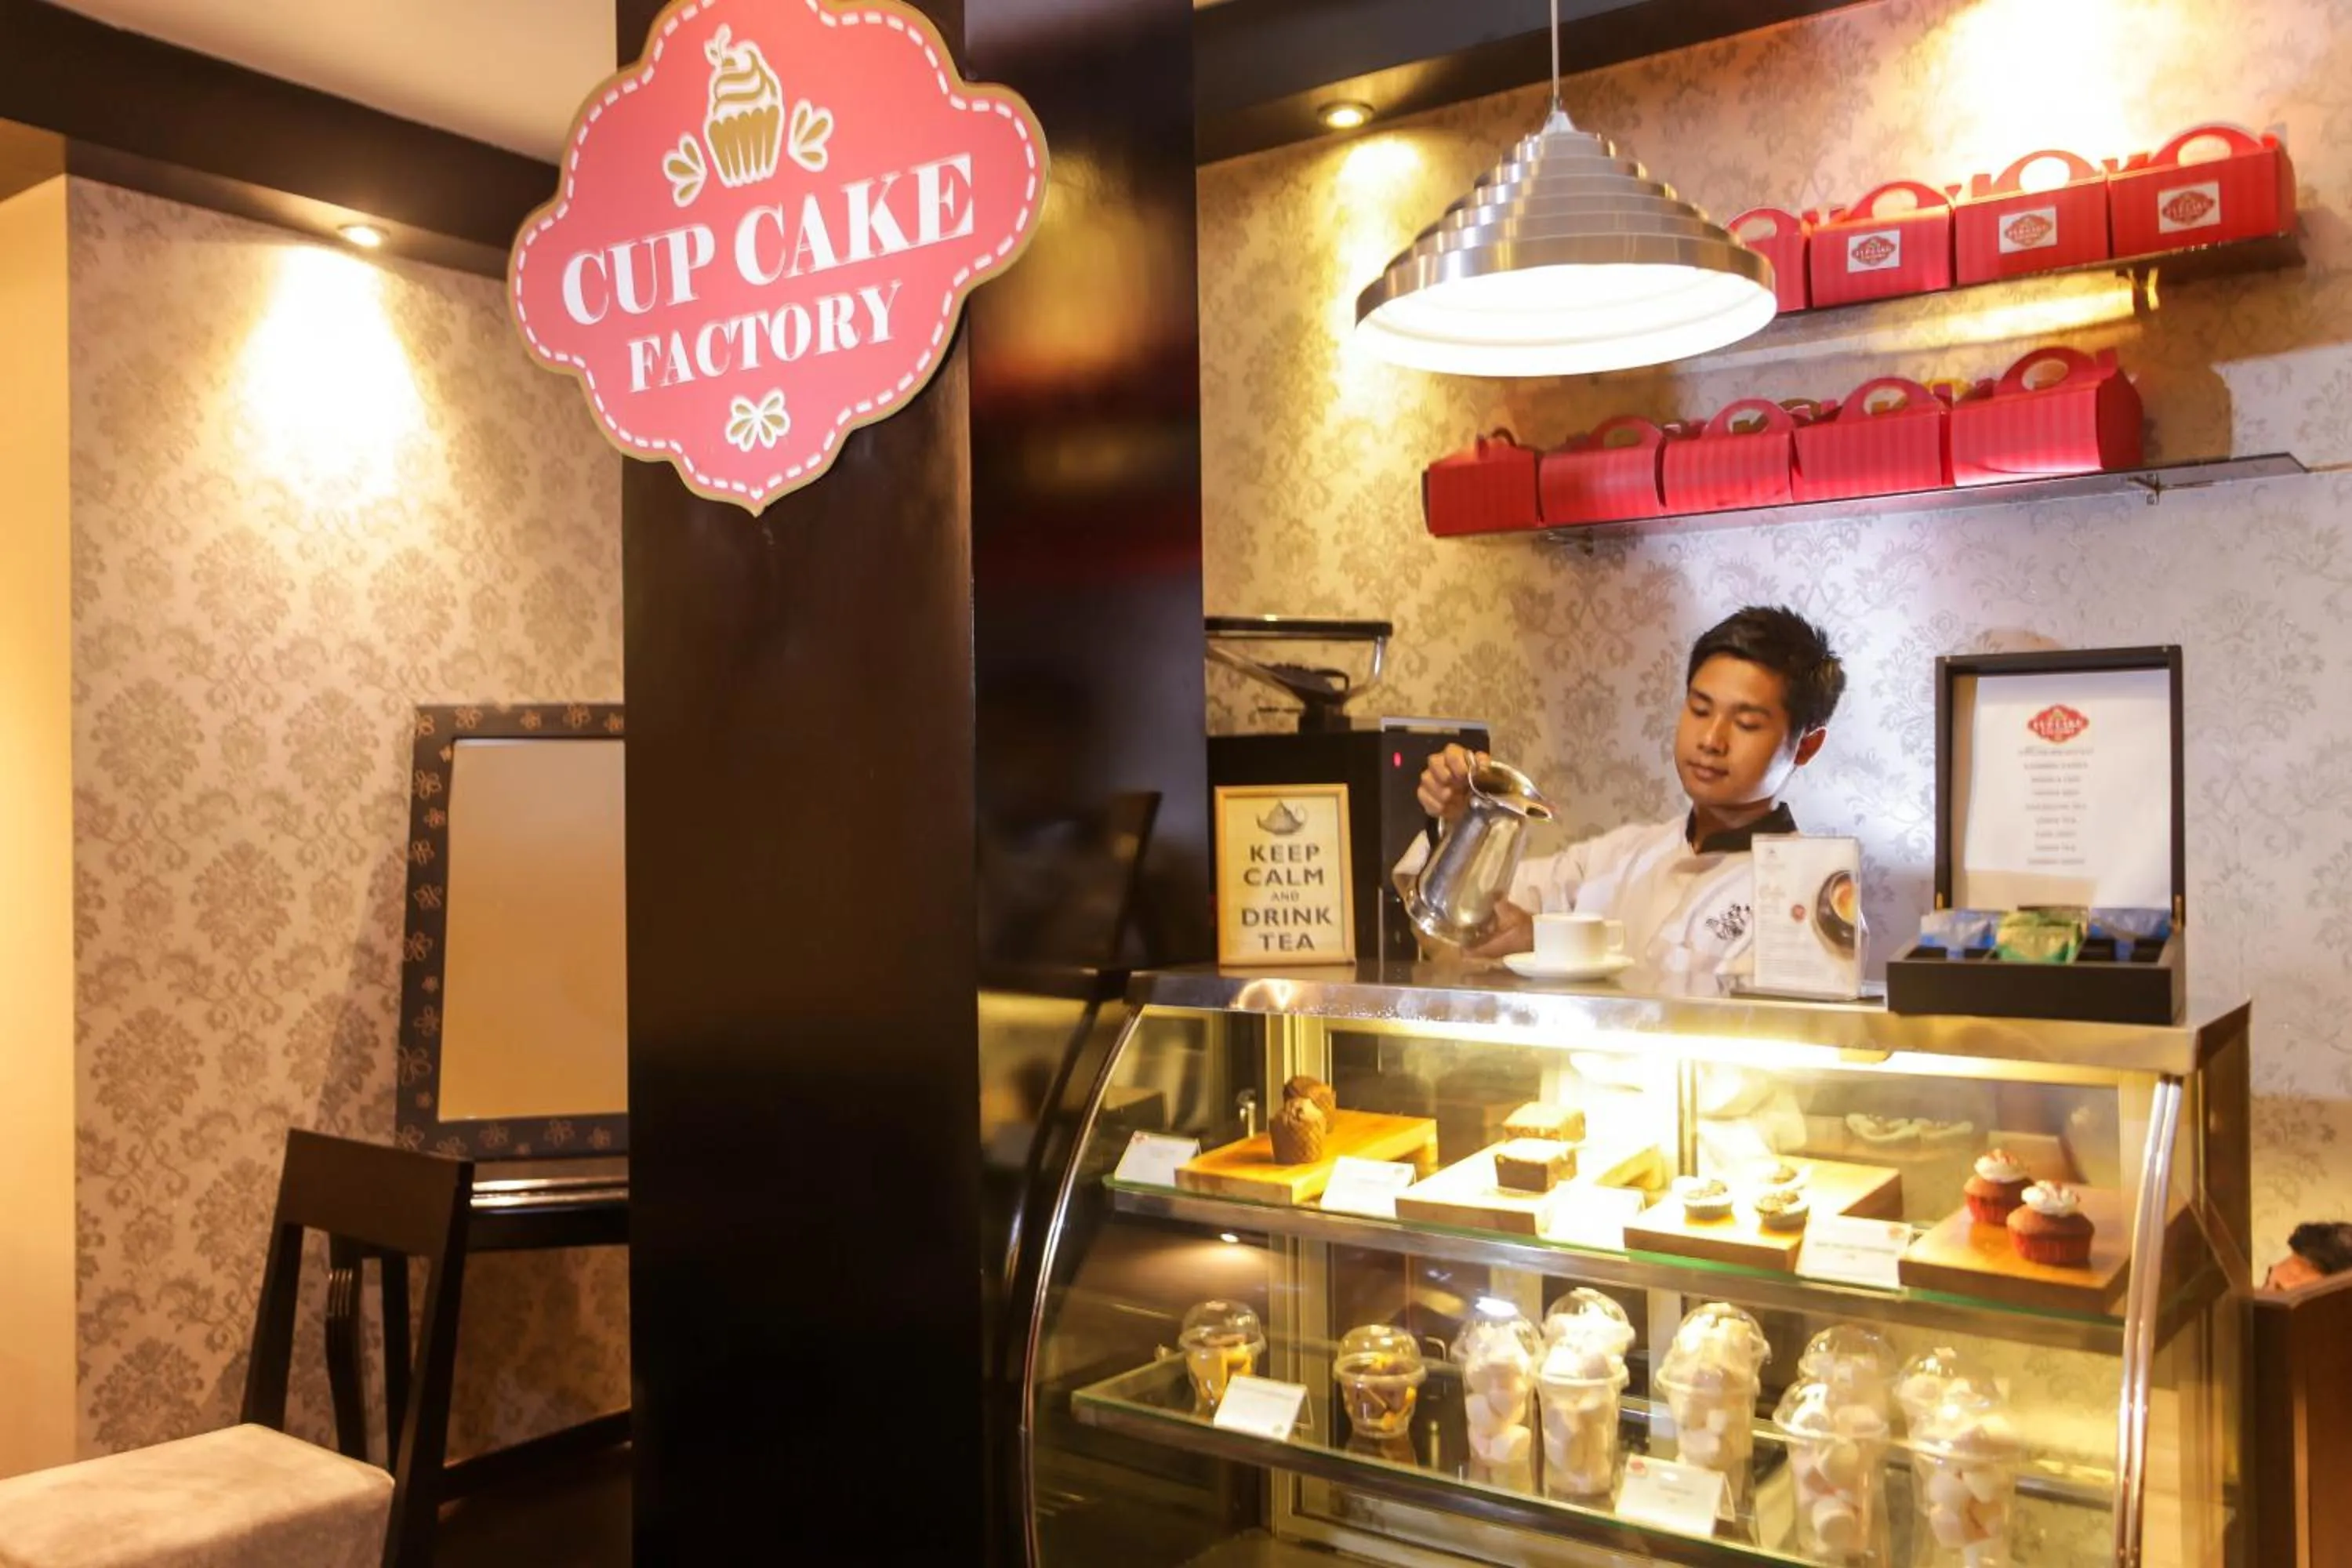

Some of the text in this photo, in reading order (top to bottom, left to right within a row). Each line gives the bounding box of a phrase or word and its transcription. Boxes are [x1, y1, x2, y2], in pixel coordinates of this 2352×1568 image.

[561, 153, 975, 325] CUP CAKE
[627, 280, 902, 393] FACTORY
[1250, 844, 1320, 863] KEEP
[1243, 868, 1324, 886] CALM
[1270, 891, 1300, 902] AND
[1242, 907, 1332, 927] DRINK
[1258, 932, 1315, 952] TEA
